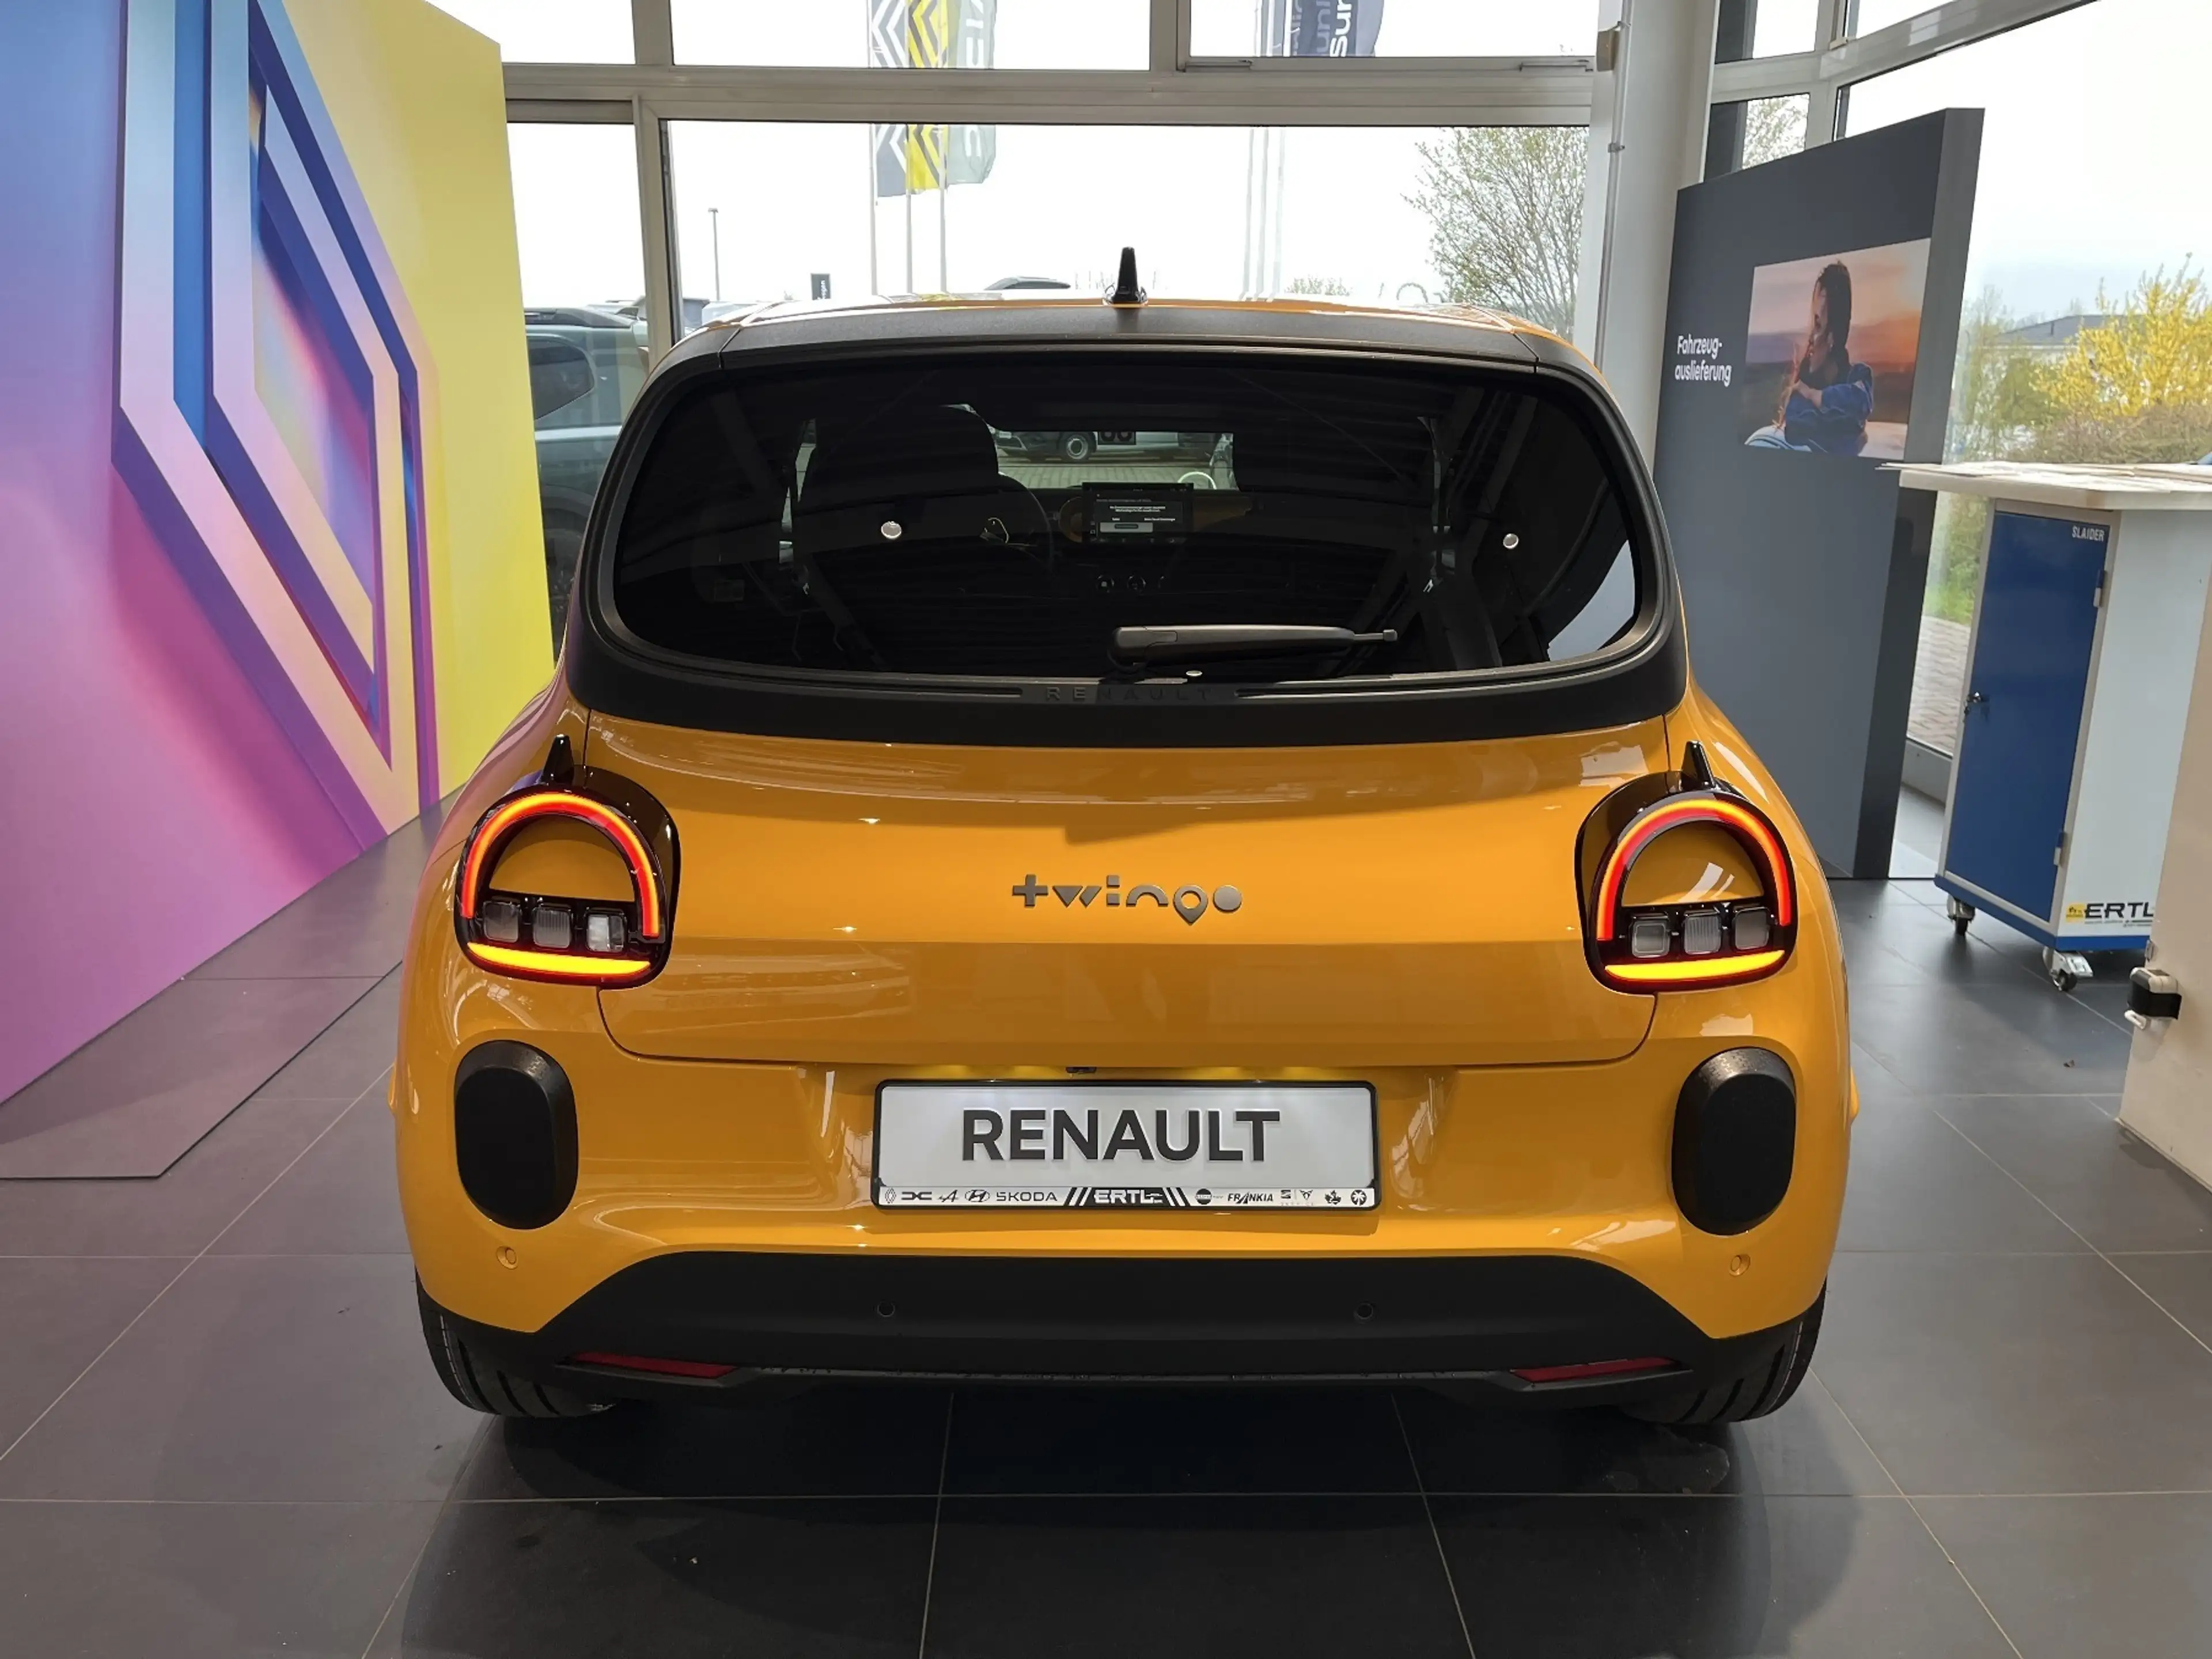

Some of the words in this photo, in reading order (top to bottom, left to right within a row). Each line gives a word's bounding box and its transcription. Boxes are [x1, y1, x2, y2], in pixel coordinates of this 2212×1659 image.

[1677, 333, 1722, 359] Fahrzeug-
[1675, 359, 1732, 387] auslieferung
[2072, 525, 2105, 541] SLAIDER
[1046, 687, 1211, 702] RENAULT
[962, 1109, 1280, 1161] RENAULT
[1228, 1191, 1274, 1205] FRANKIA
